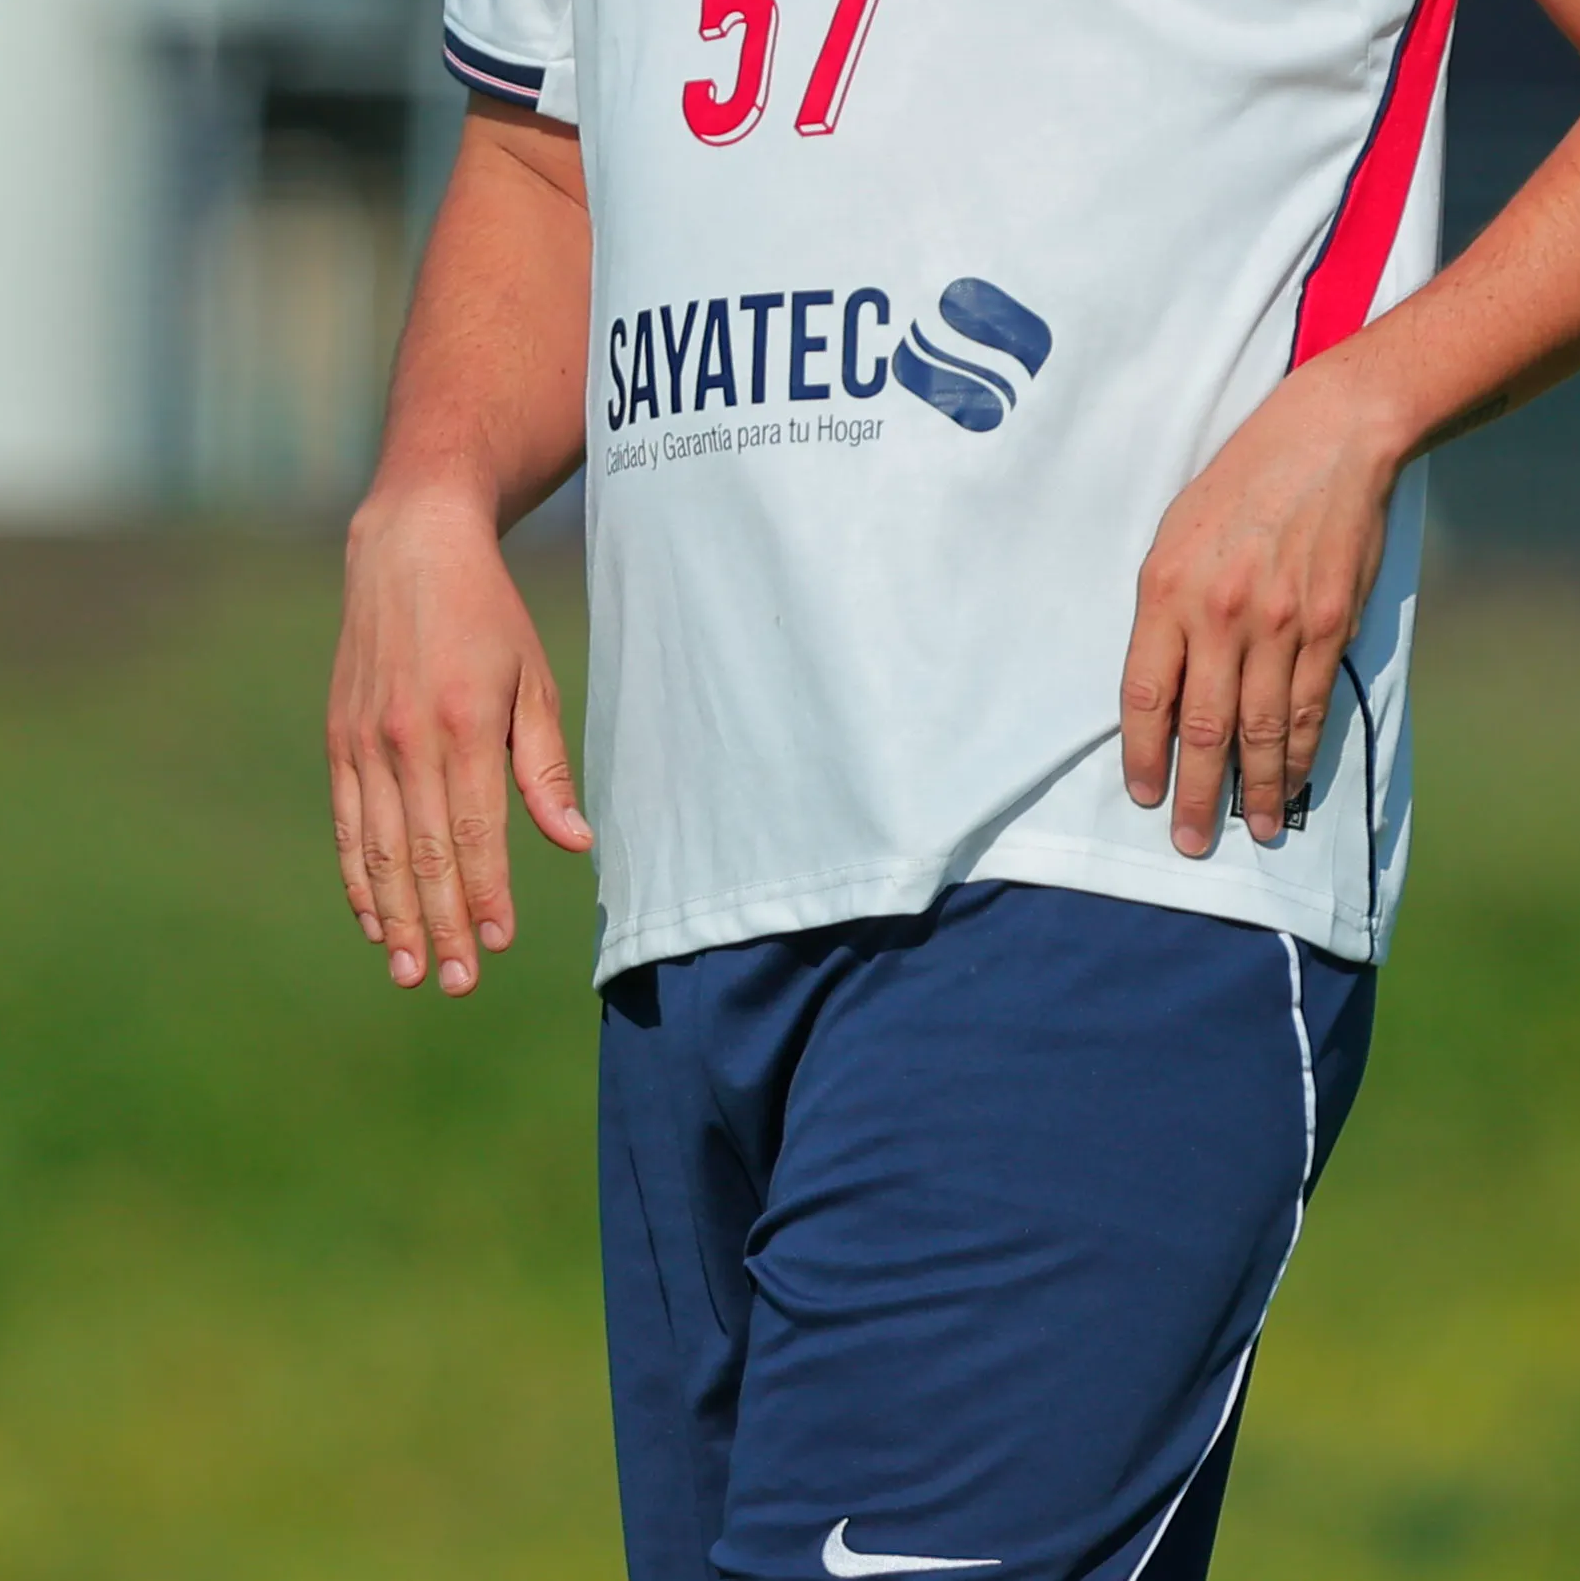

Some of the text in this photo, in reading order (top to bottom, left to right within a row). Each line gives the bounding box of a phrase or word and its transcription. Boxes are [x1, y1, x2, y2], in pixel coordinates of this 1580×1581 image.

[607, 287, 890, 431] SAYATEC
[606, 414, 884, 476] Calidad y Garantía para tu Hogar
